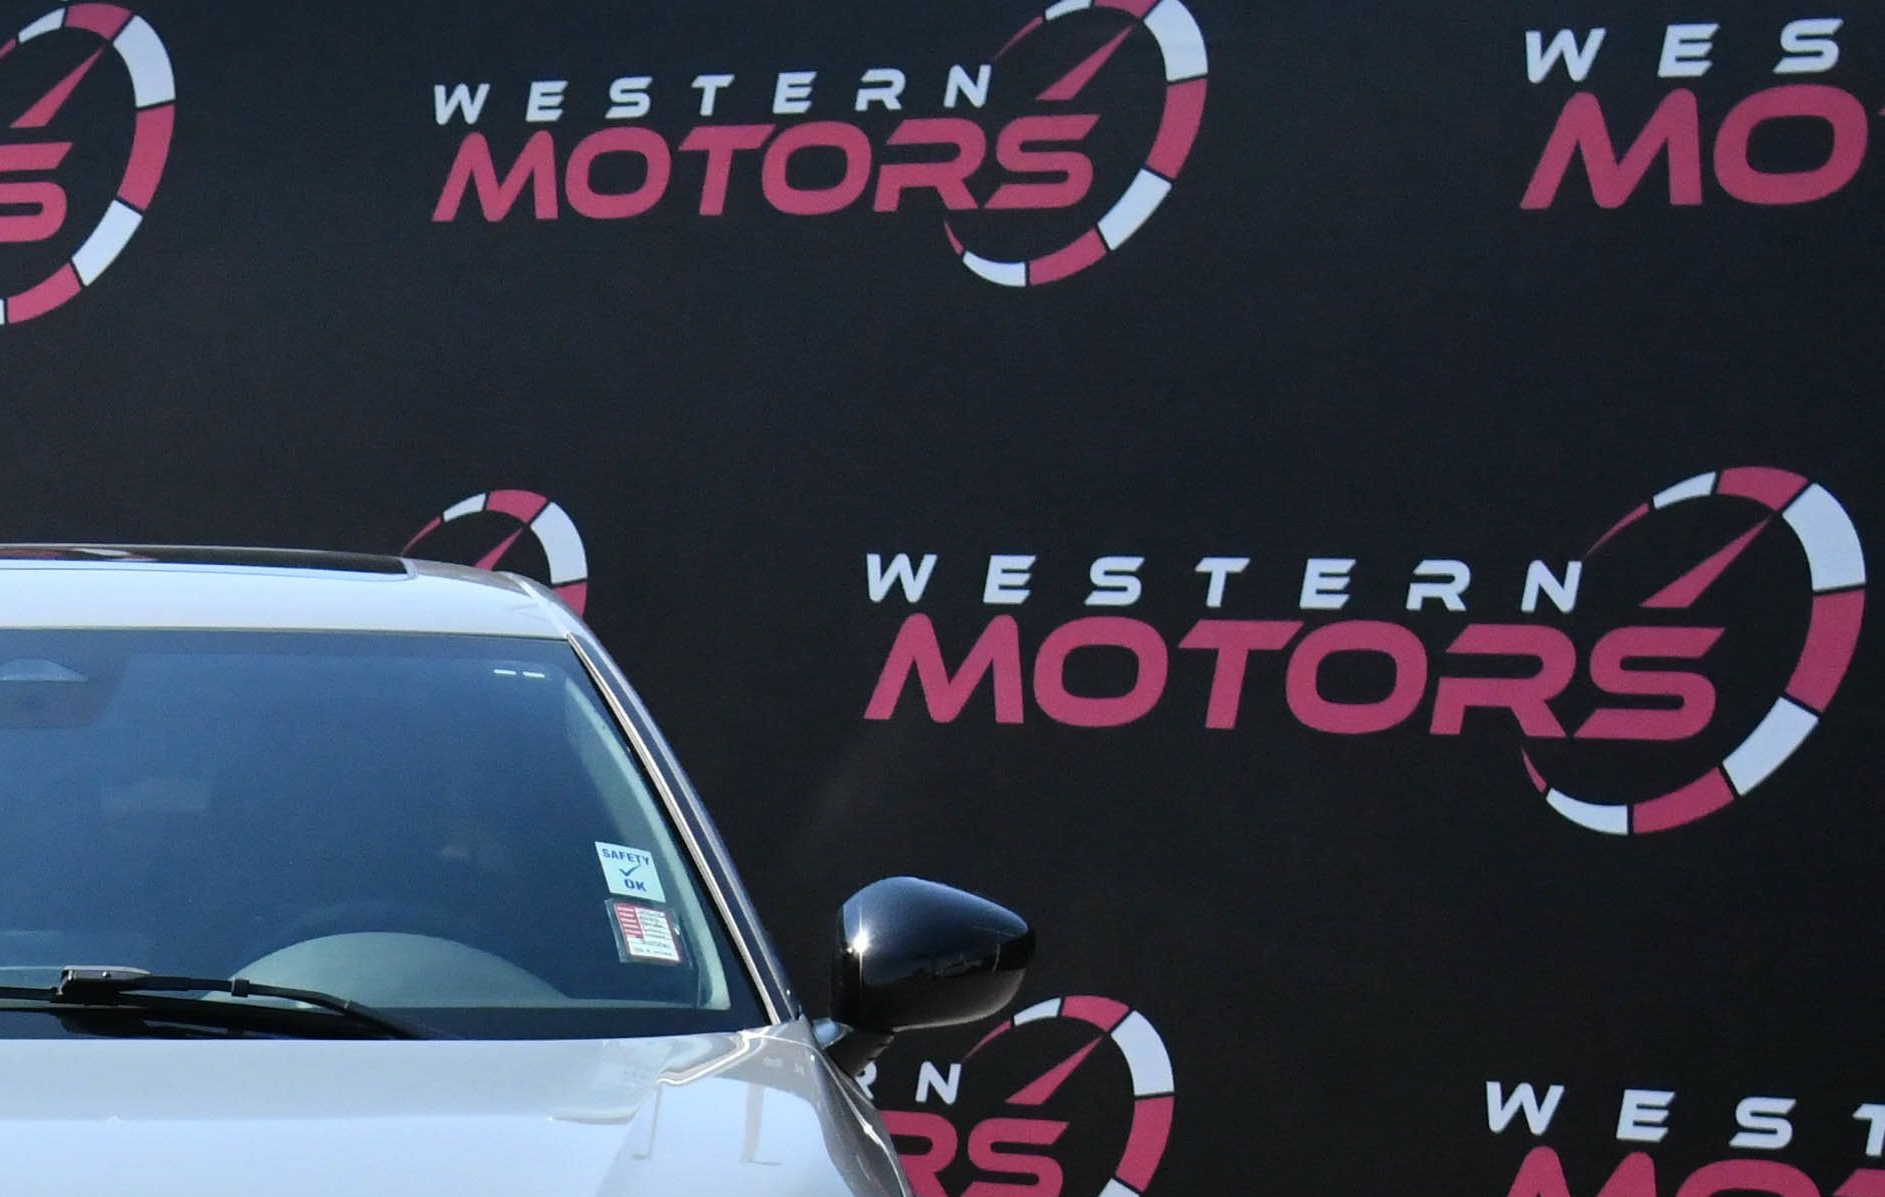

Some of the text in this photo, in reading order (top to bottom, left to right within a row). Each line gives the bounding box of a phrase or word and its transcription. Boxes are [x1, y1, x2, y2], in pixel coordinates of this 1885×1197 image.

[1524, 19, 1843, 84] WES
[433, 64, 991, 125] WESTERN
[432, 114, 1100, 222] MOTORS
[1522, 84, 1871, 209] MO
[866, 553, 1582, 613] WESTERN
[865, 613, 1726, 741] MOTORS
[601, 848, 650, 865] SAFETY
[624, 878, 647, 892] OK
